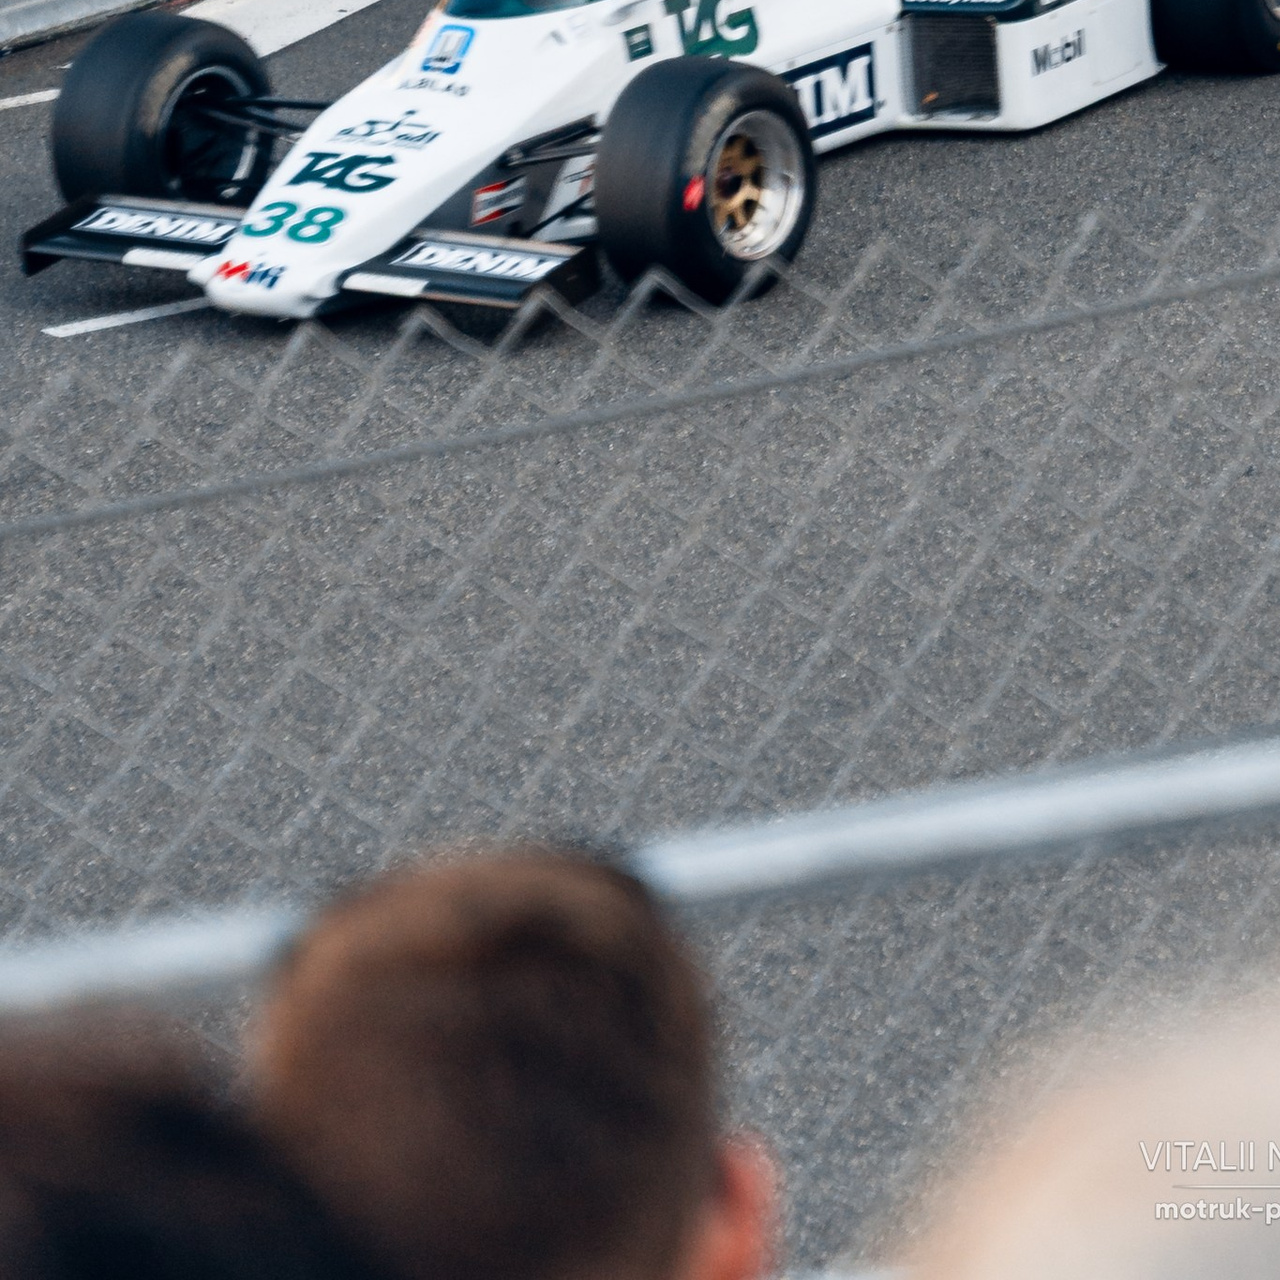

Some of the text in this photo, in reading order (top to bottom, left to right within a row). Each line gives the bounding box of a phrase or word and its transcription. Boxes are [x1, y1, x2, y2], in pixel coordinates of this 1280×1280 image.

[286, 151, 399, 194] TAG
[92, 212, 233, 244] DENIM
[241, 201, 346, 244] 38
[408, 245, 561, 278] DENIM
